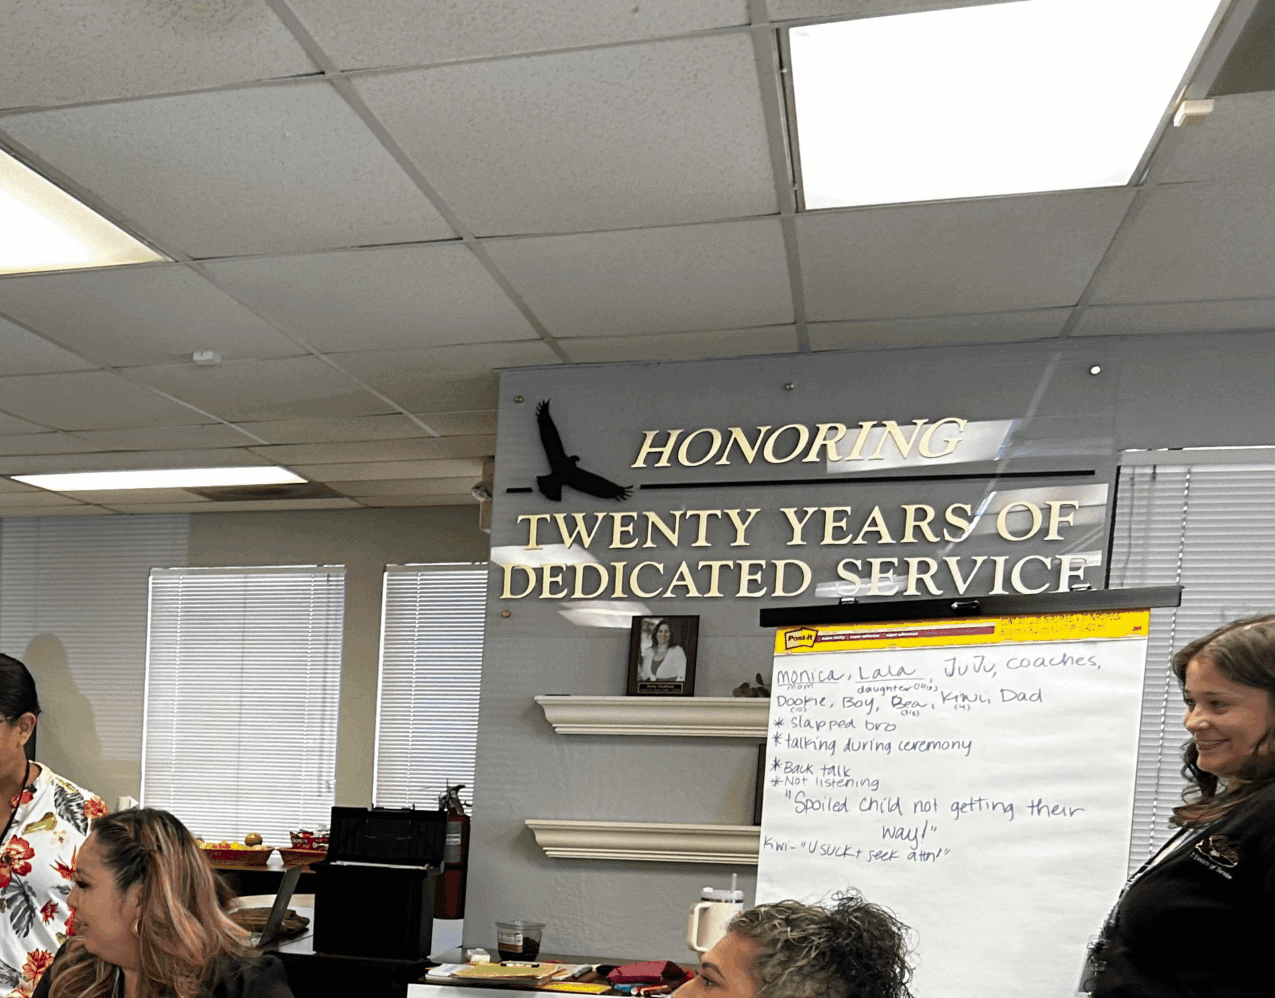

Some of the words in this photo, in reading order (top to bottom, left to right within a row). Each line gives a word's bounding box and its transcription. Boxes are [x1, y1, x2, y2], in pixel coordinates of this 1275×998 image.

[631, 417, 968, 469] HONORING
[516, 507, 761, 550] TWENTY
[779, 501, 974, 546] YEARS
[996, 500, 1081, 542] OF
[499, 559, 812, 600] DEDICATED
[835, 554, 1089, 598] SERVICE
[842, 696, 880, 715] Boy,
[1000, 688, 1043, 703] Dad
[857, 684, 913, 696] daughter
[865, 719, 897, 732] bro
[785, 732, 836, 757] talking
[843, 737, 892, 755] during
[898, 737, 973, 757] ceremony
[784, 761, 814, 775] Back
[820, 764, 851, 778] talk
[784, 775, 809, 786] Not
[815, 776, 880, 792] listening
[913, 797, 938, 813] not
[950, 799, 1015, 820] getting
[1026, 800, 1085, 818] their
